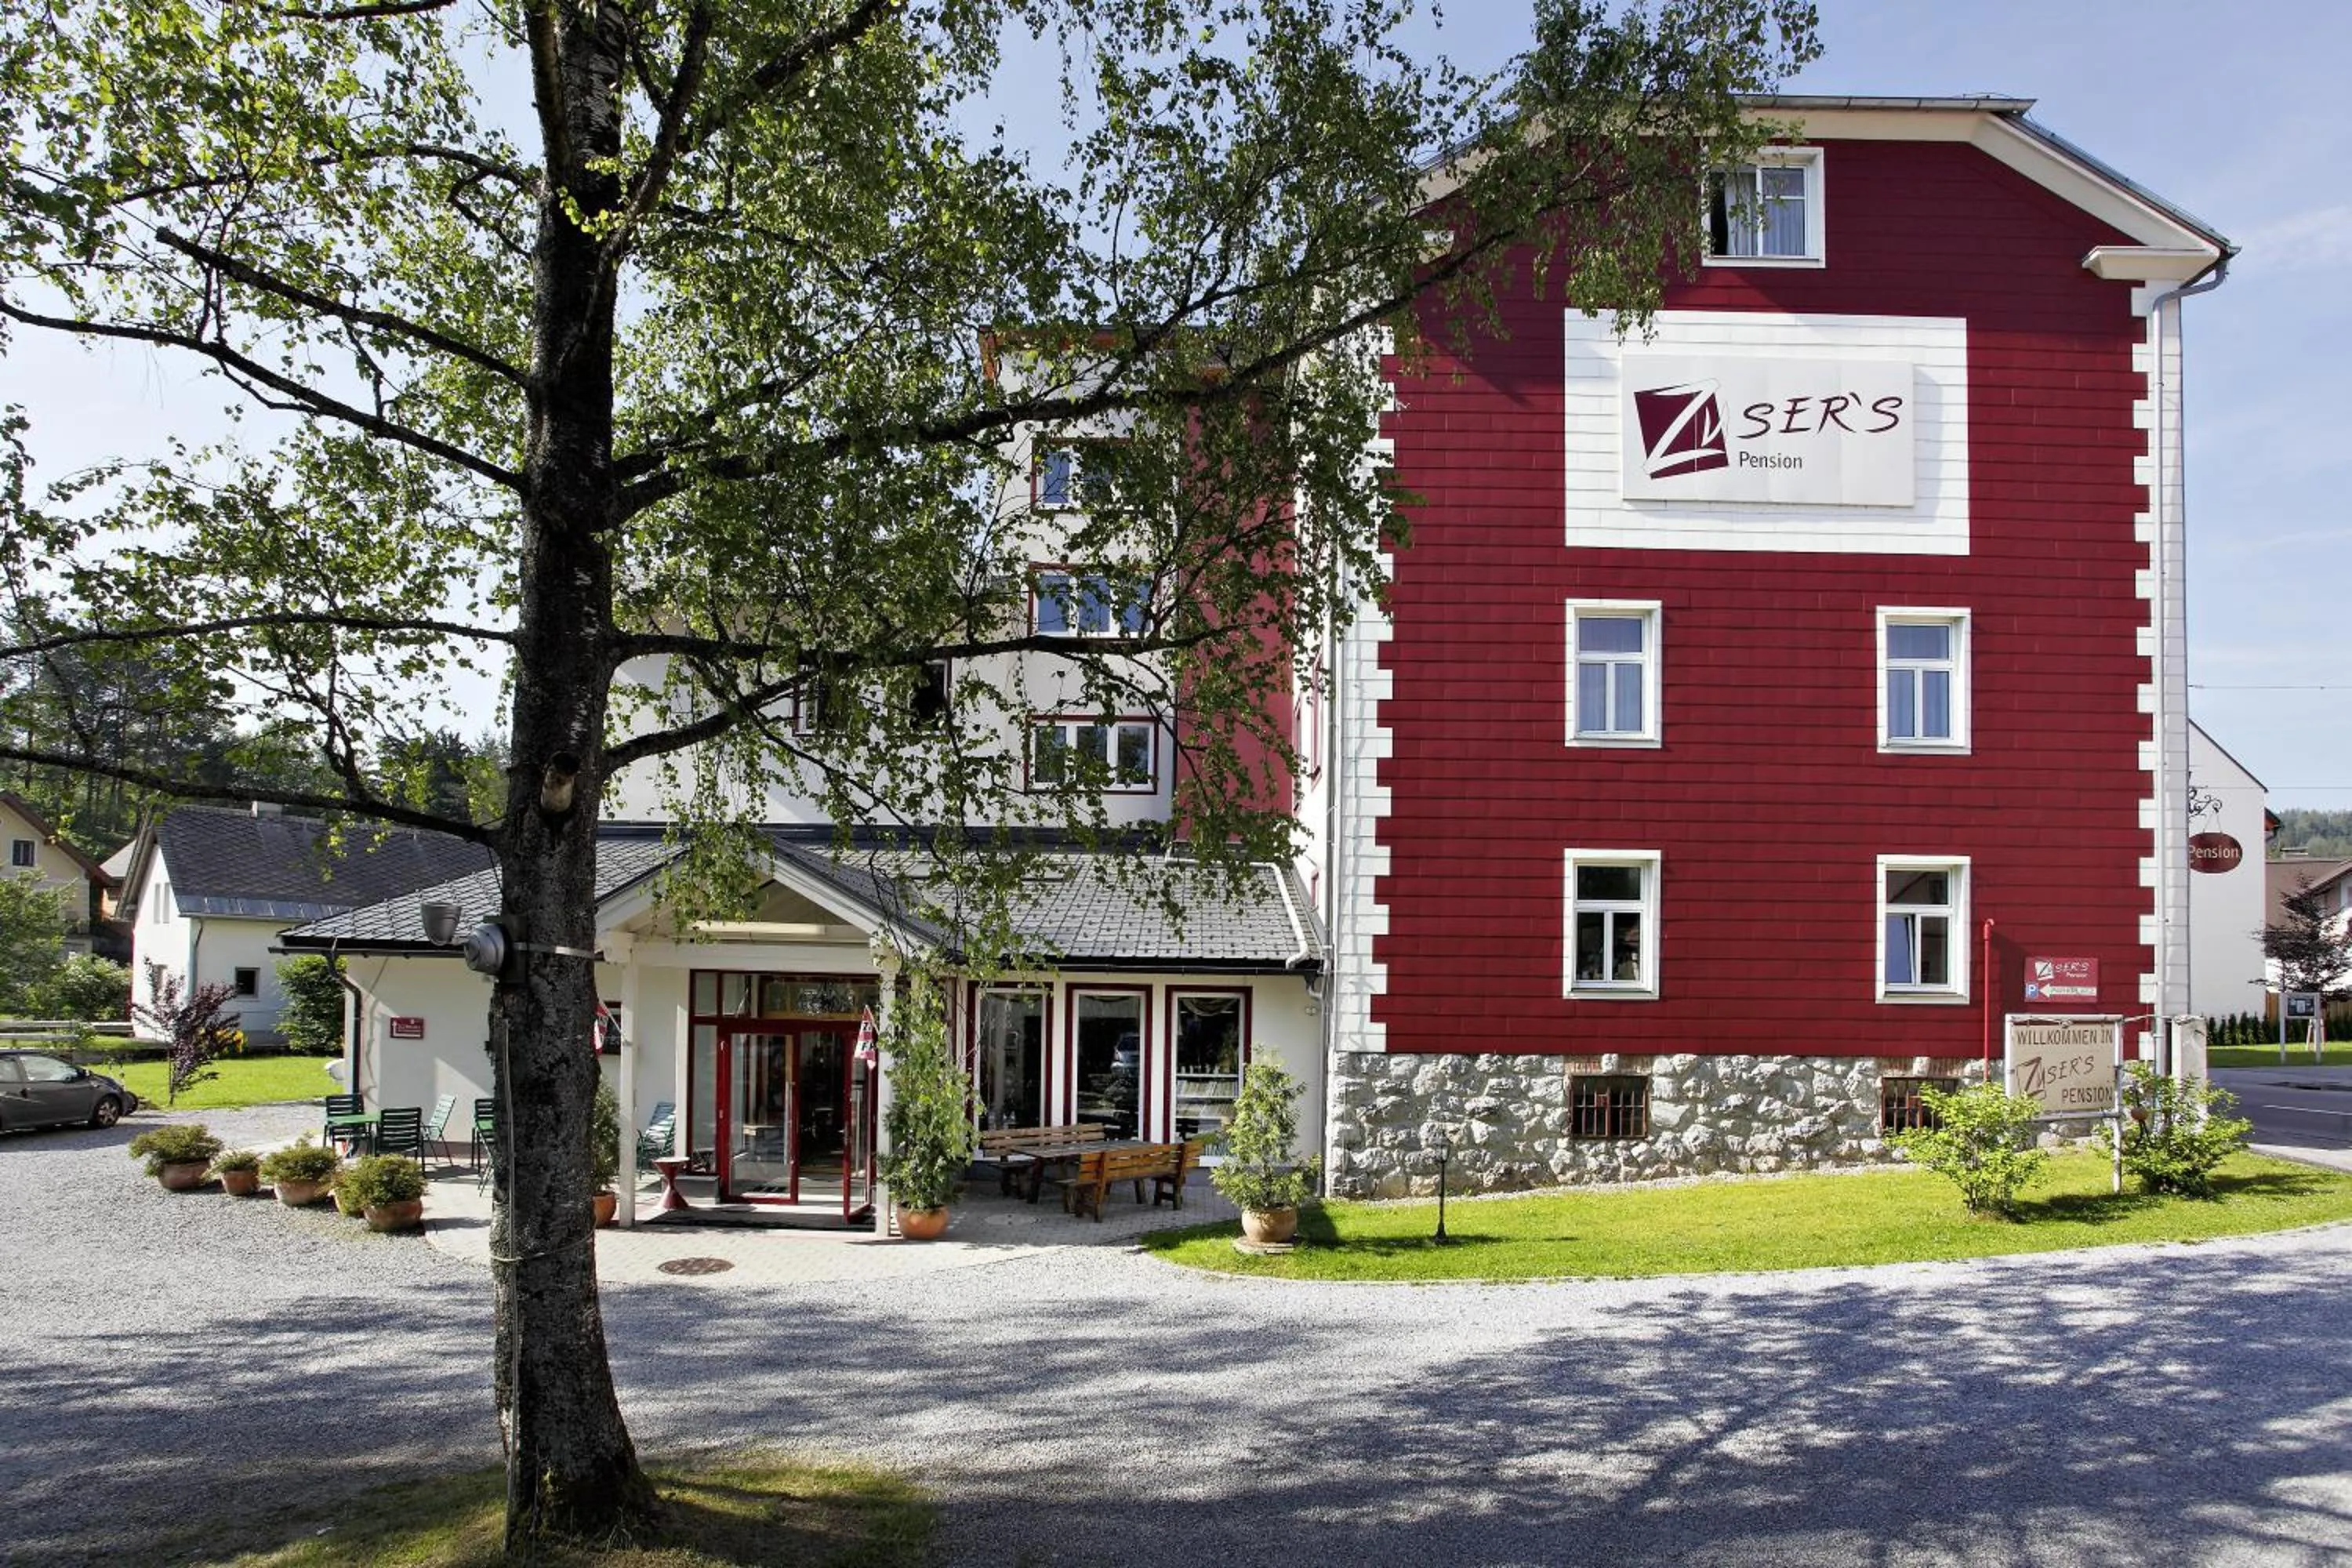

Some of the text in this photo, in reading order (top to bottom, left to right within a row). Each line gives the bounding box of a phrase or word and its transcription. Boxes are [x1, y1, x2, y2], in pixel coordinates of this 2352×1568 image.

[1739, 451, 1803, 470] Pension
[2028, 984, 2036, 996] P
[2016, 1029, 2113, 1045] WILLKOMMEN IN
[2061, 1087, 2113, 1104] PENSION
